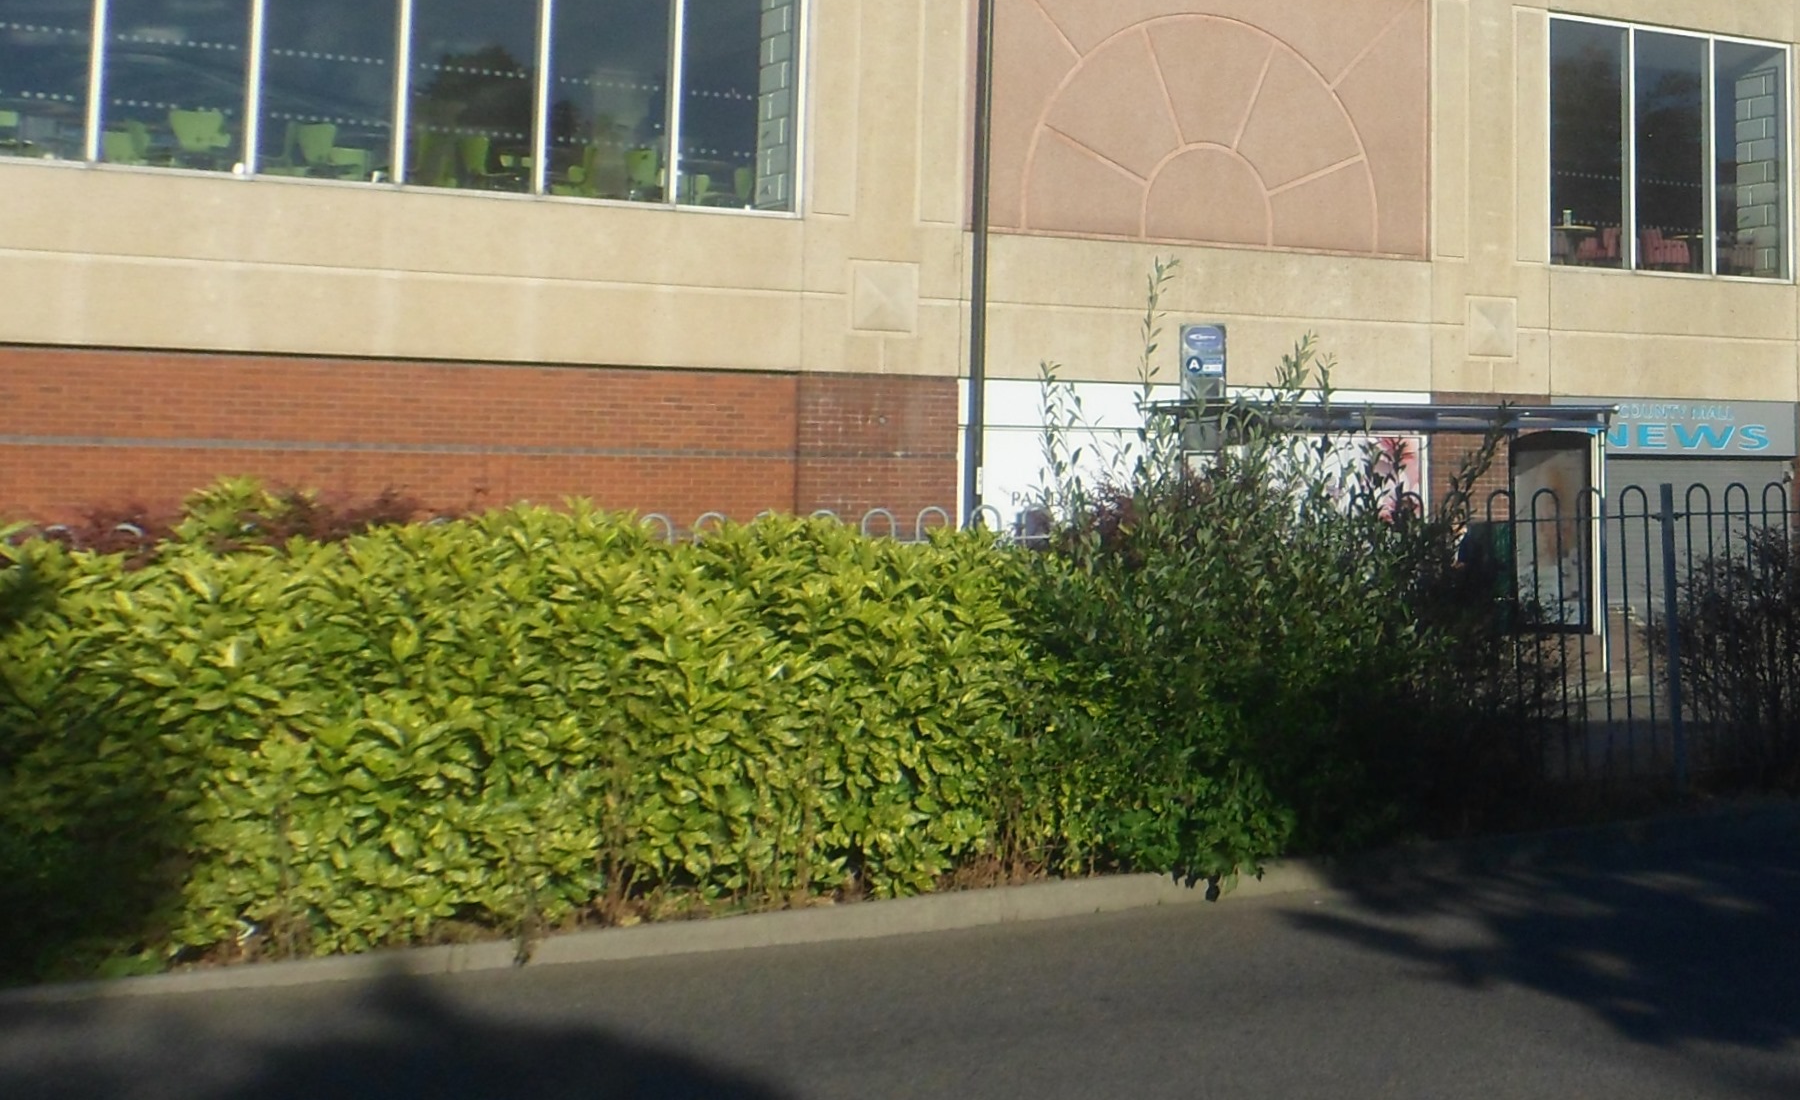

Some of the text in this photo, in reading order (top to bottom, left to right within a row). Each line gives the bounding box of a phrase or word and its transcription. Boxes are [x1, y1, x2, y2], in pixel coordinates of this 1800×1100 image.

[1188, 358, 1200, 370] A
[1619, 403, 1735, 421] COUNTY MALL
[1588, 422, 1772, 451] NEWS
